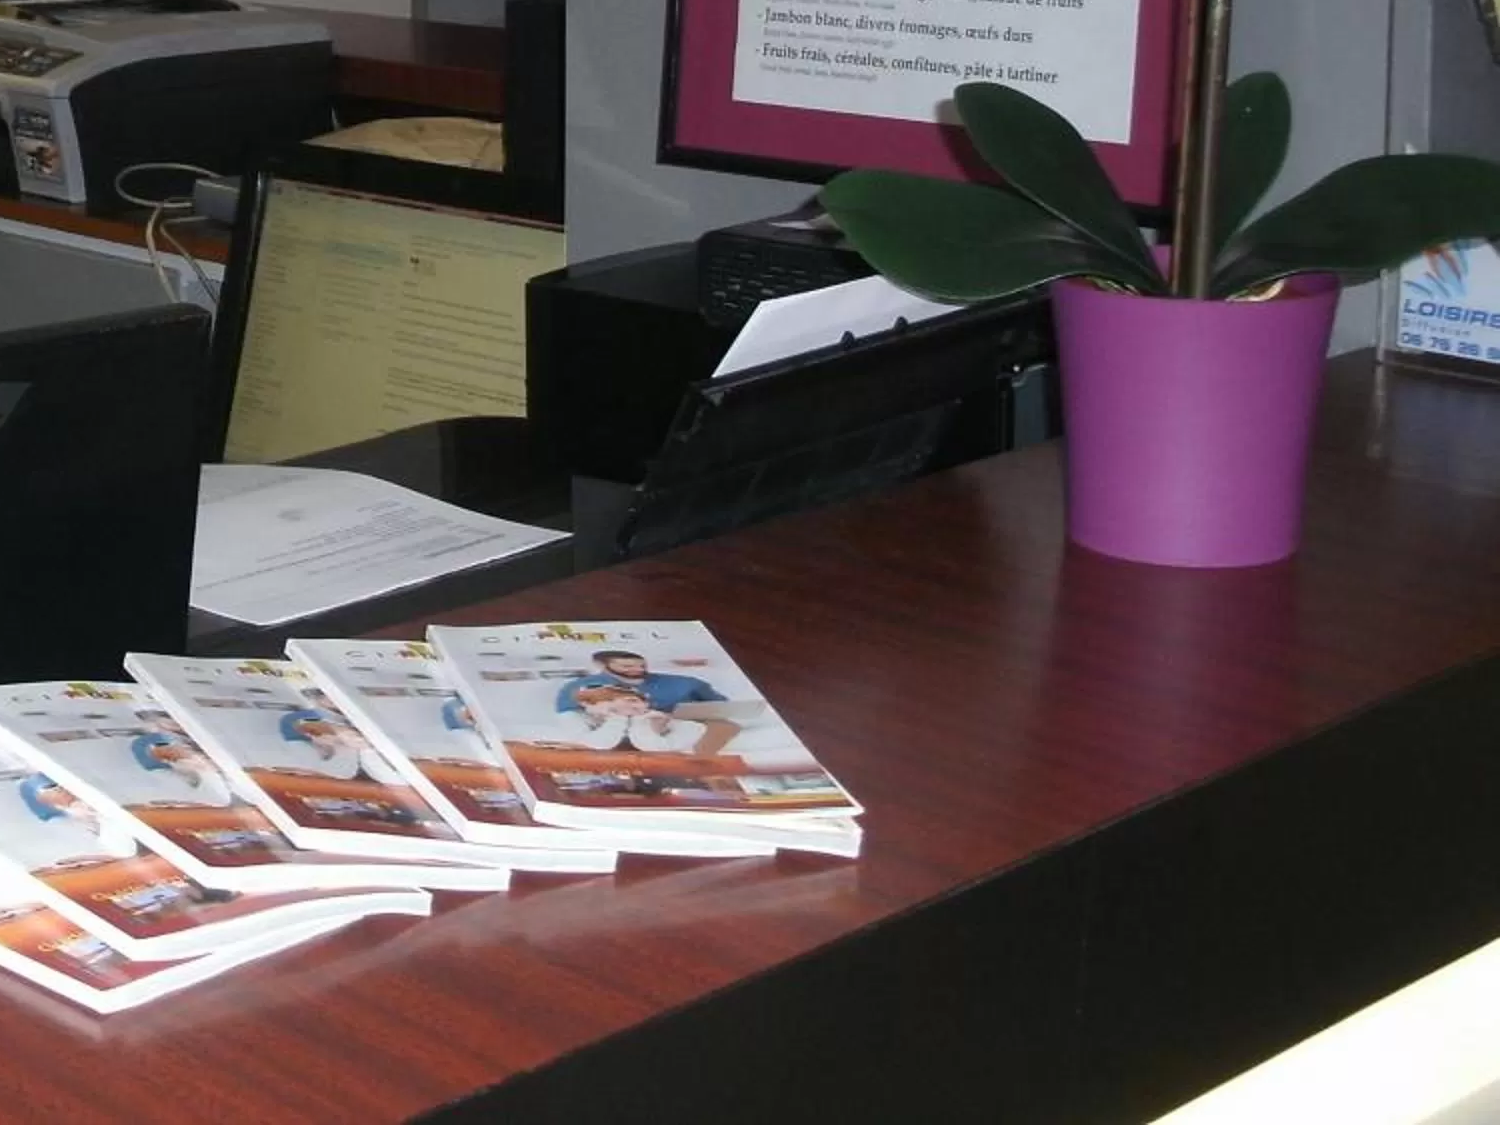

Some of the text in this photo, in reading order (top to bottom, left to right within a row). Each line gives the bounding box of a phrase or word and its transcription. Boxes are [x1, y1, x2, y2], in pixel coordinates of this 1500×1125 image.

[765, 8, 811, 25] Jambon
[855, 16, 895, 32] divers
[899, 19, 961, 40] fromages,
[1003, 28, 1034, 44] durs
[762, 44, 798, 61] Fruits
[801, 47, 832, 64] frais,
[835, 50, 888, 70] céréales,
[892, 55, 960, 76] confitures,
[964, 62, 992, 80] pâte
[995, 63, 1004, 79] à
[1007, 66, 1058, 84] tartiner
